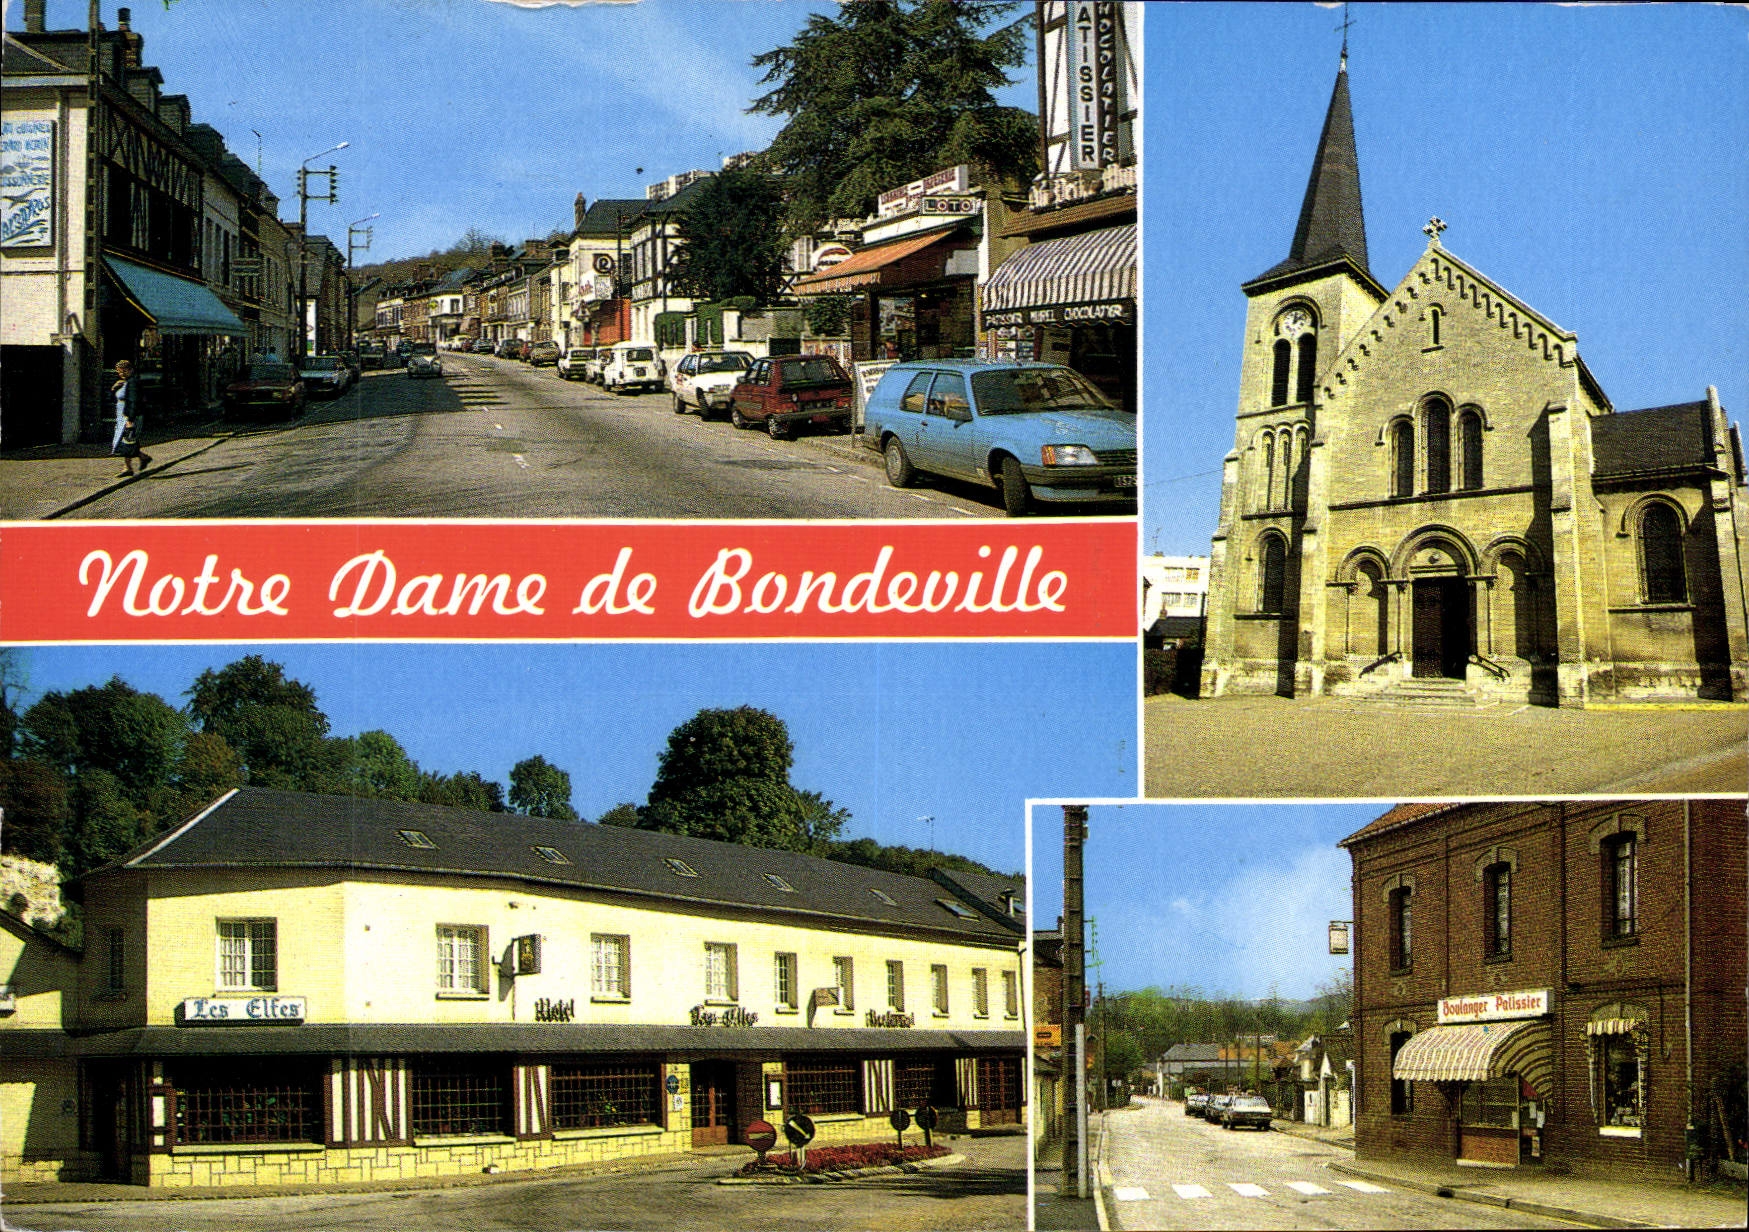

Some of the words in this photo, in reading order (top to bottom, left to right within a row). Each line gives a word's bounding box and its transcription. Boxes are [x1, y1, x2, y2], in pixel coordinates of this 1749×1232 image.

[1077, 1, 1095, 162] ATISSIER
[1098, 2, 1115, 162] HOCOLATIER
[925, 199, 973, 212] LOTO
[1064, 304, 1124, 321] CHOCOLATIER
[192, 997, 229, 1019] Les
[245, 997, 301, 1019] Elfes
[1443, 1000, 1488, 1018] Boulanger
